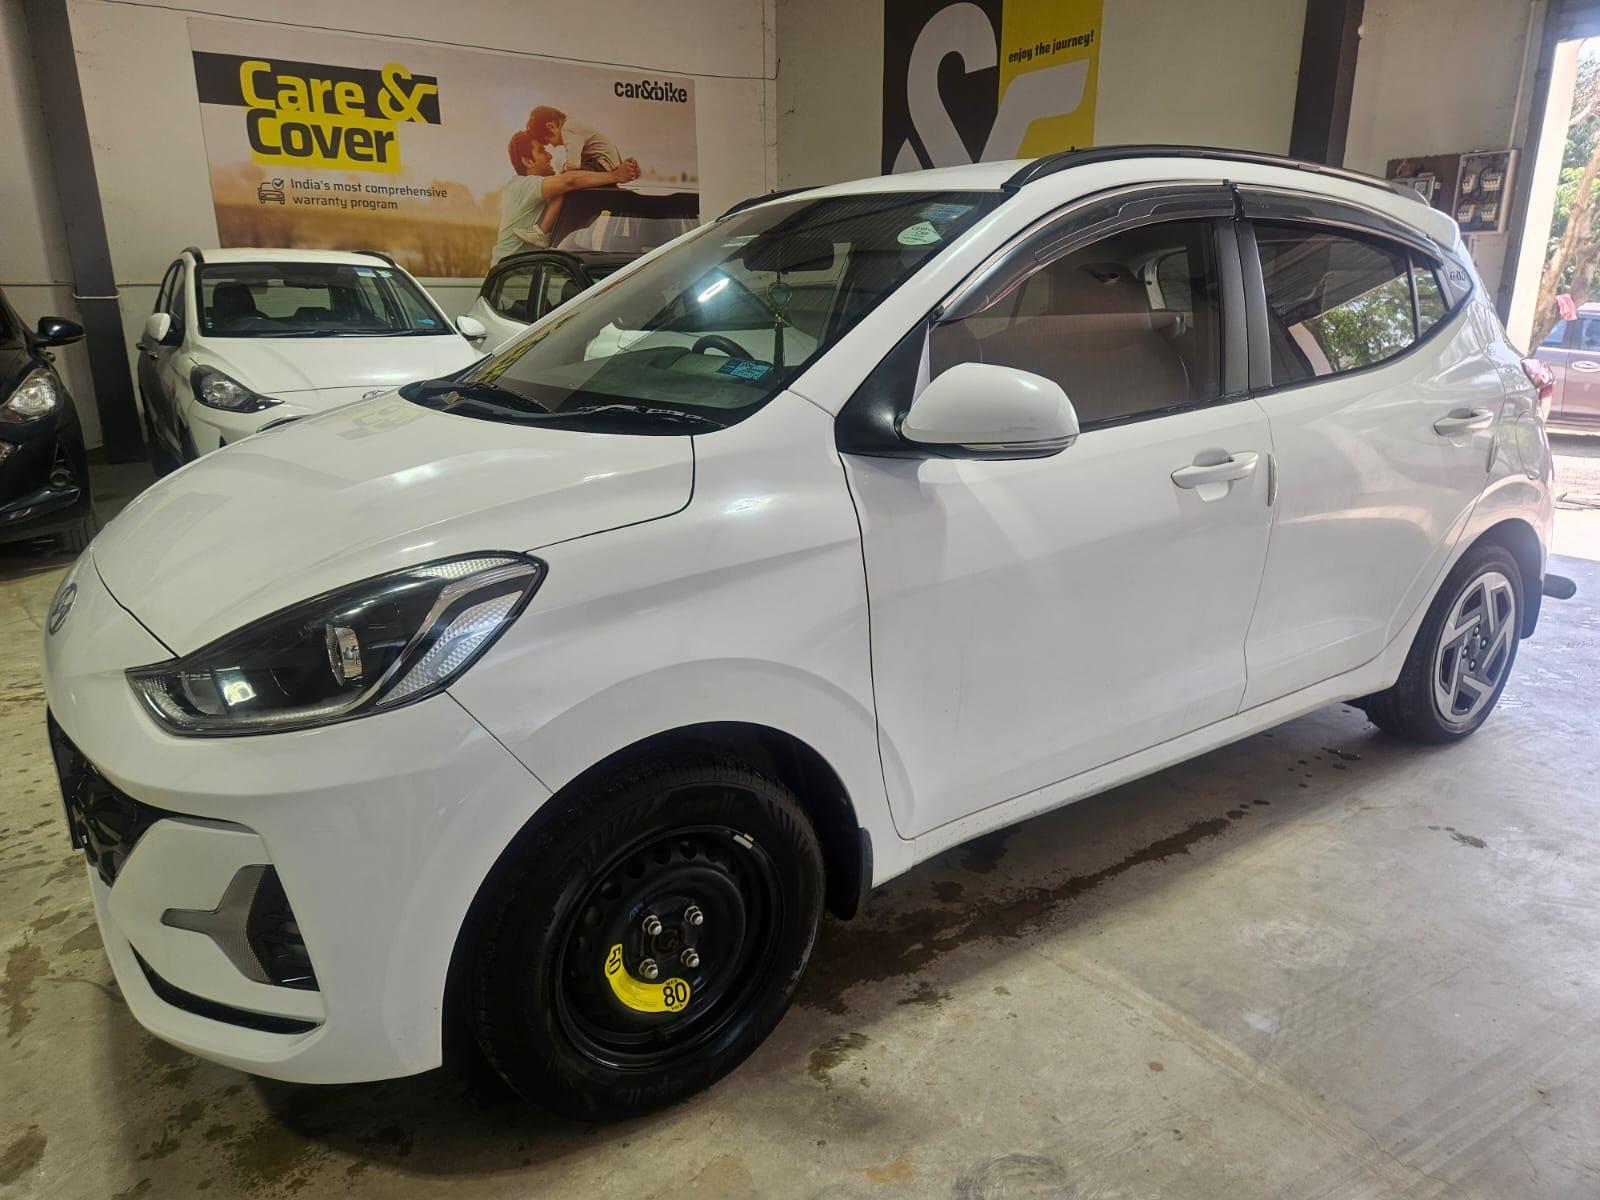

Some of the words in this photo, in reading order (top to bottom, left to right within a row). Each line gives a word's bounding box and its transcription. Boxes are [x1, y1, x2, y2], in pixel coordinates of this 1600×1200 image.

[1008, 48, 1033, 63] enjoy
[1035, 42, 1050, 56] the
[1052, 29, 1095, 55] journey!
[240, 60, 366, 118] Care
[377, 62, 438, 124] &
[246, 108, 395, 163] Cover
[290, 178, 331, 191] India's
[333, 182, 362, 193] most
[365, 183, 448, 198] comprehensive
[292, 196, 348, 209] warranty
[351, 199, 398, 211] program
[663, 982, 687, 1006] 80
